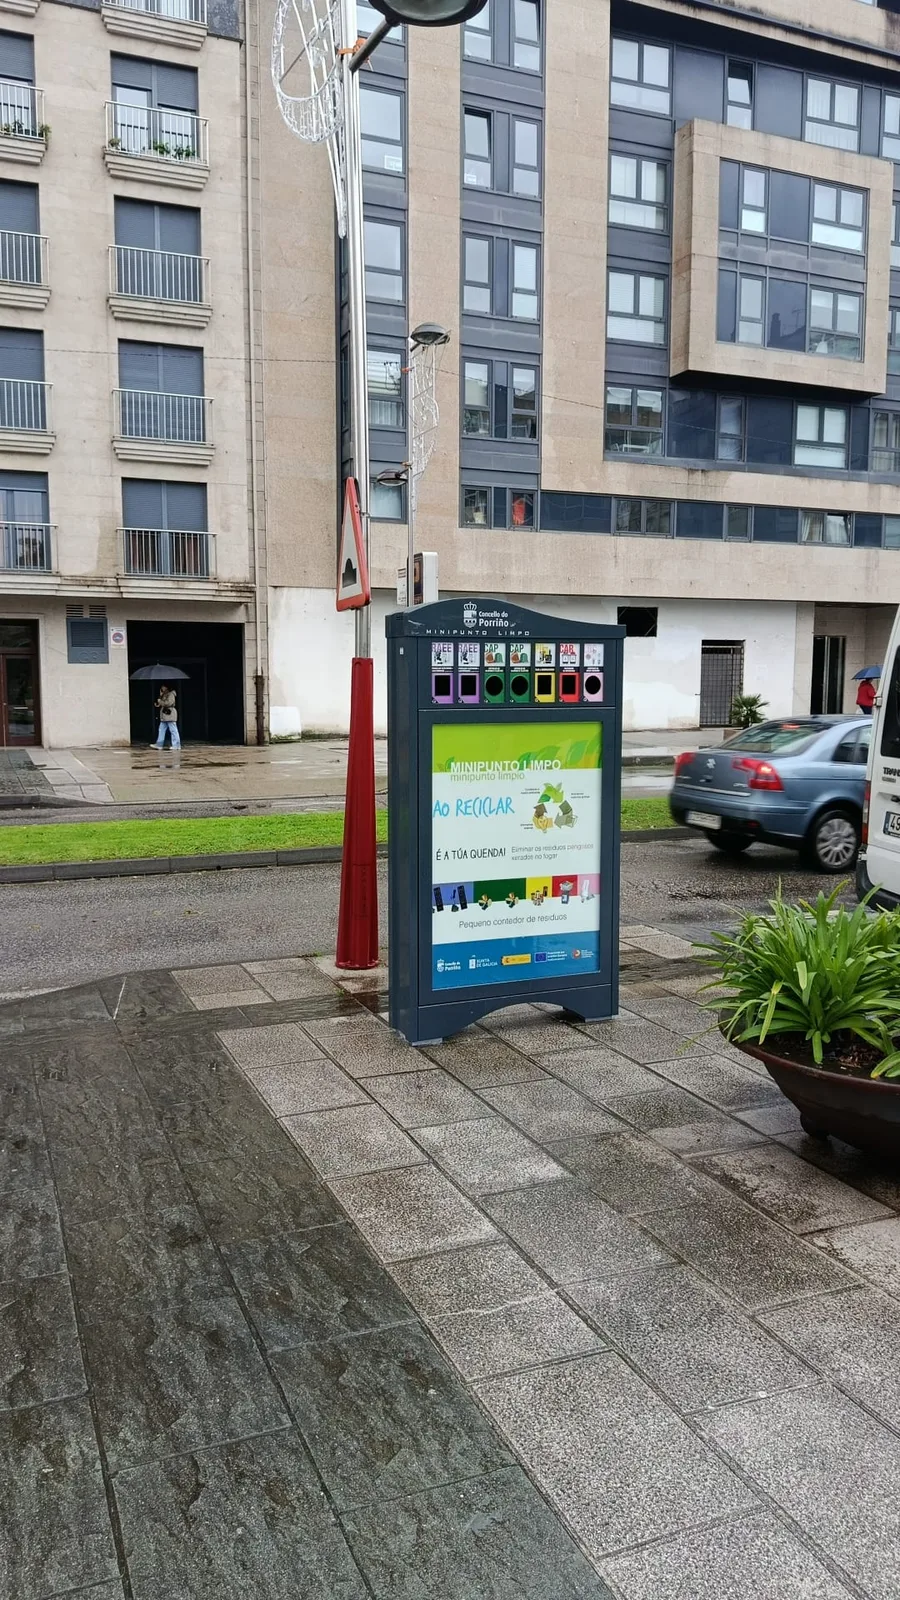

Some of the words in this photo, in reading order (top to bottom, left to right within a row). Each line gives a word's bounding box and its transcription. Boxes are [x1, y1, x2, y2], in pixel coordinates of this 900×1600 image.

[478, 610, 500, 618] Concello
[500, 610, 509, 618] do
[478, 617, 509, 628] Porriño
[450, 760, 520, 773] MINIPUNTO
[523, 759, 562, 771] LIMPO
[450, 772, 496, 783] minipunto
[432, 800, 450, 818] AO
[455, 796, 515, 817] RECICLAR
[436, 848, 442, 861] É
[443, 850, 450, 861] A
[451, 848, 468, 860] TÚA
[458, 919, 491, 929] Pequeno
[492, 917, 525, 926] contedor
[537, 913, 568, 922] residuos
